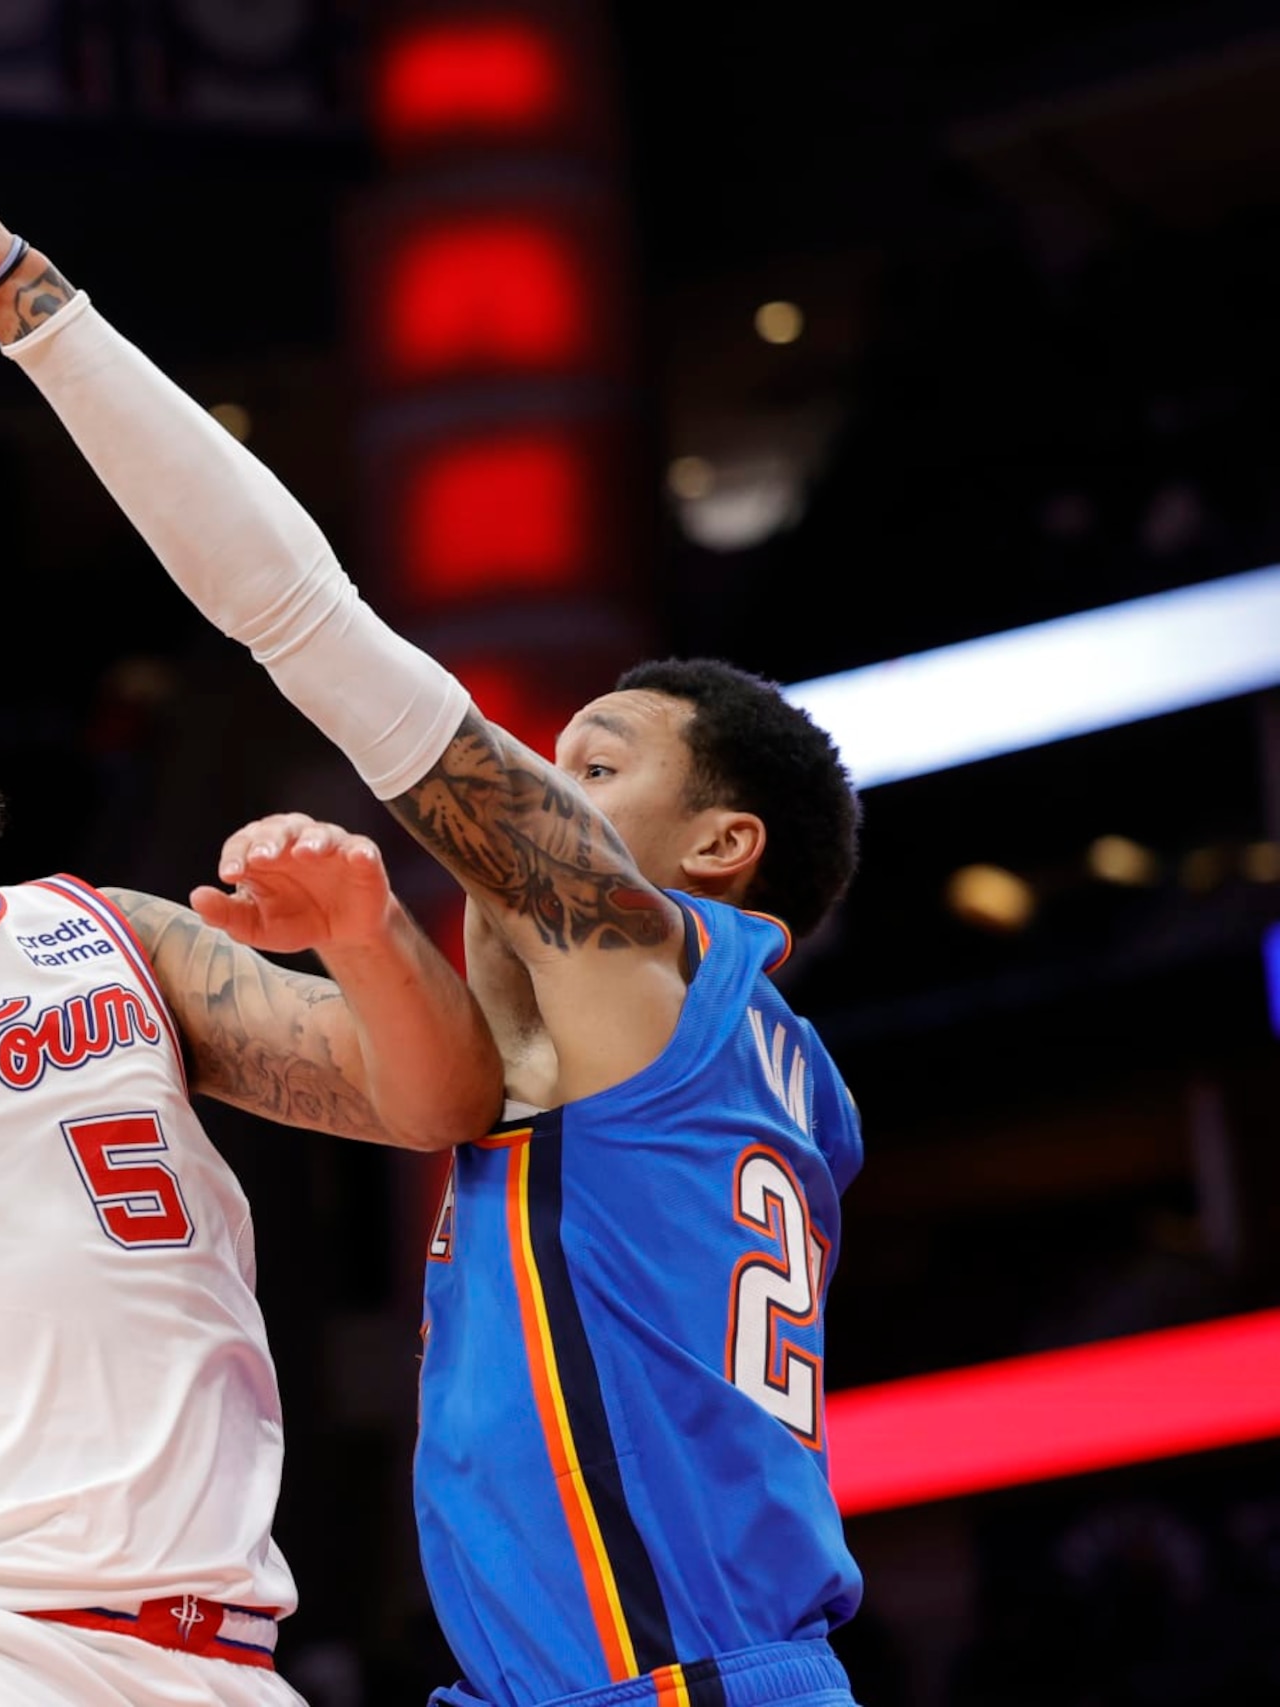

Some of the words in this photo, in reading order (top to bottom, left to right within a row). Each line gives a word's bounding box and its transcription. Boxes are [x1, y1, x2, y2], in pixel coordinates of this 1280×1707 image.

[16, 917, 98, 949] credit
[22, 939, 115, 967] karma
[60, 1110, 194, 1250] 5
[725, 1143, 831, 1452] 2
